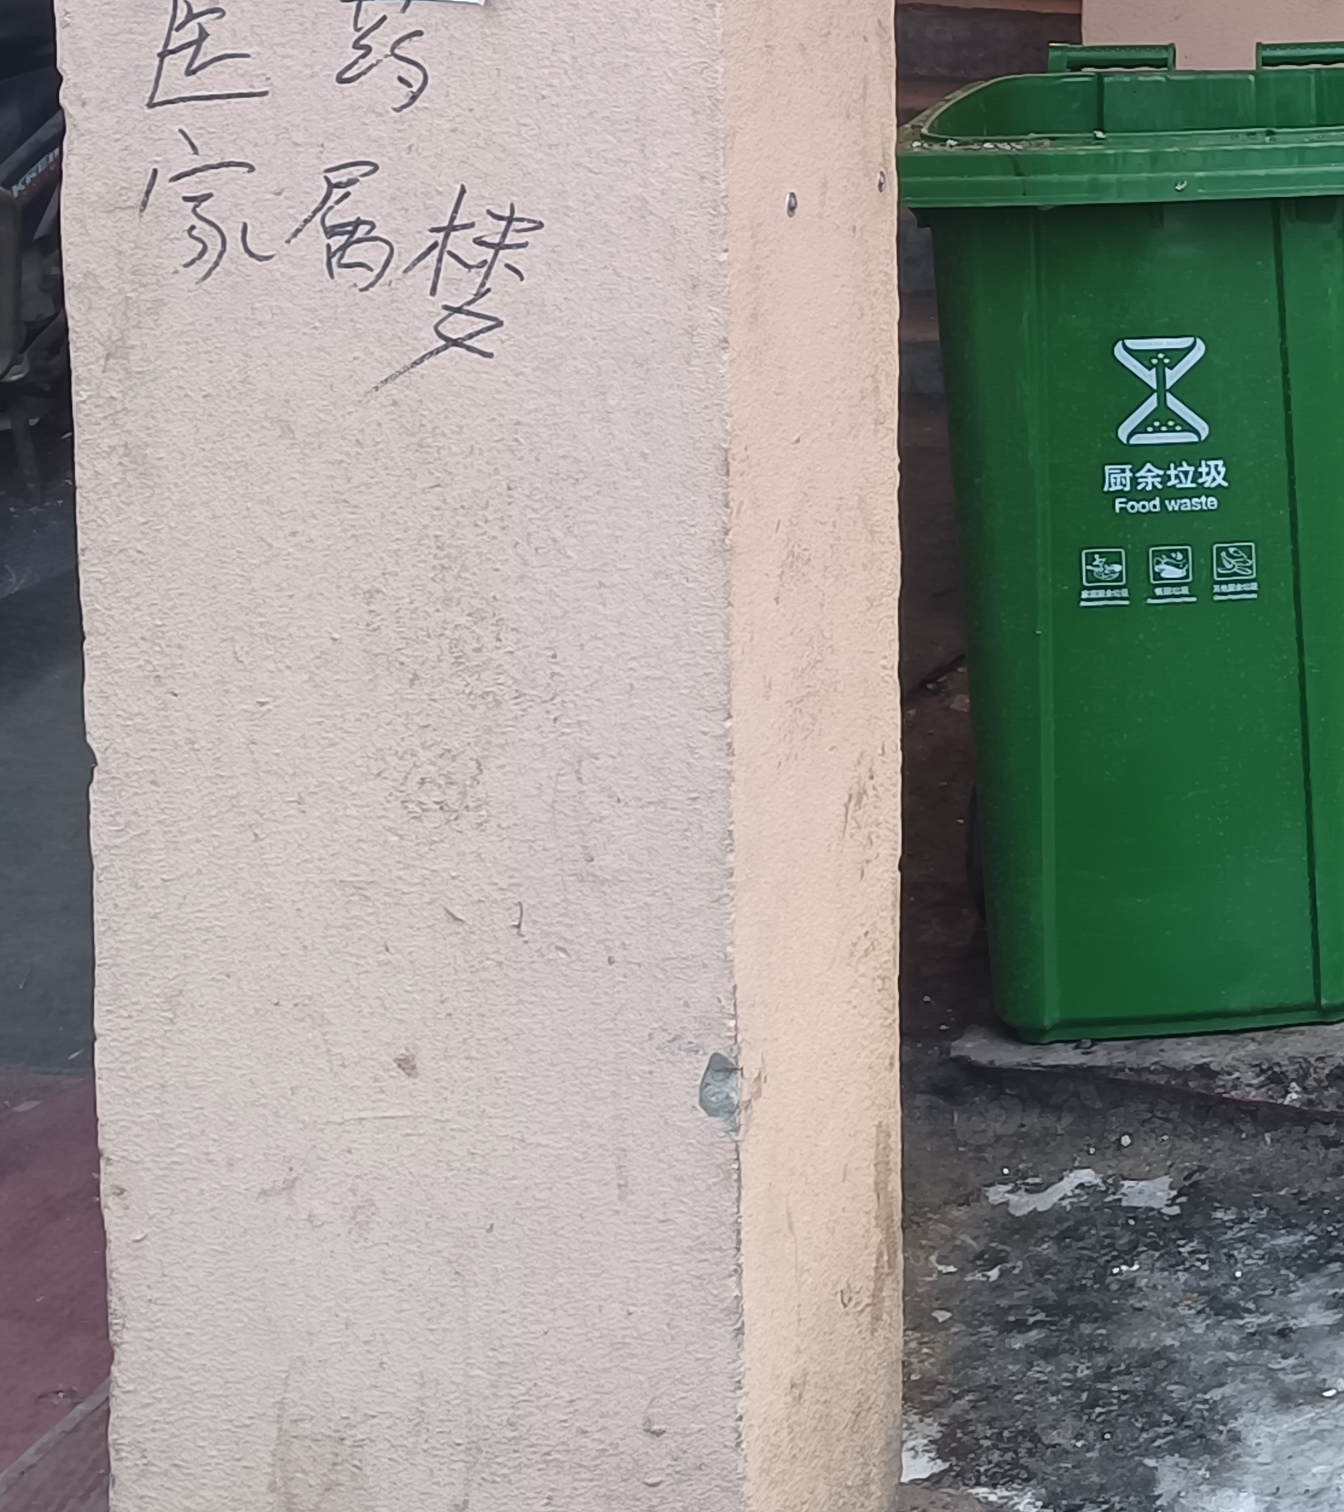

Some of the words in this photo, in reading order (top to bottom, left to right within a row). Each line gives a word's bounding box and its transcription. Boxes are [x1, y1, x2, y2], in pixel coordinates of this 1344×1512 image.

[1102, 459, 1230, 493] 厨余垃圾
[1114, 496, 1161, 514] Food
[1164, 494, 1219, 512] waste
